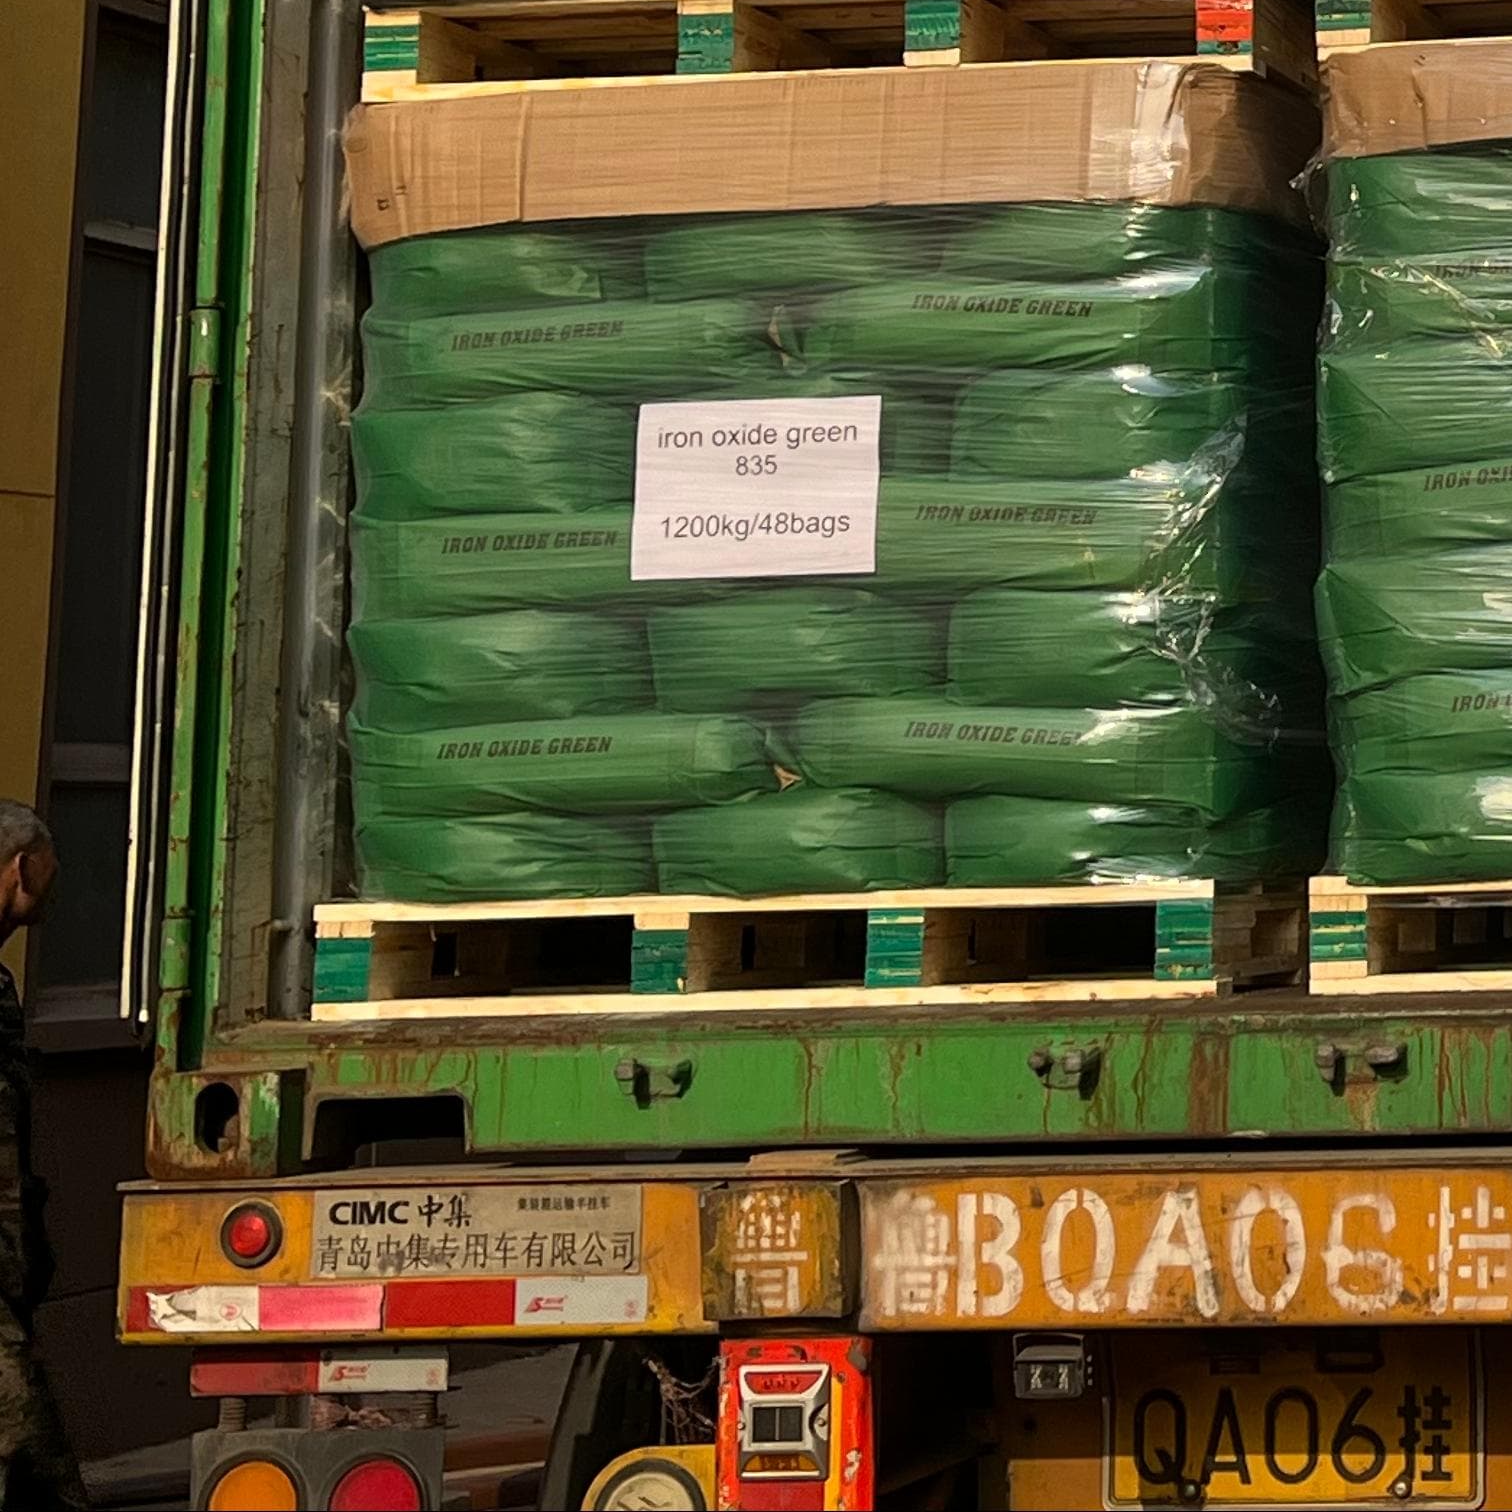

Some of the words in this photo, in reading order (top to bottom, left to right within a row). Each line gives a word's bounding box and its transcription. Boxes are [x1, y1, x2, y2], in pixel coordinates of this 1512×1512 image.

[912, 294, 961, 311] IRON
[963, 296, 1024, 314] OXIDE
[1025, 299, 1094, 318] GREEN
[451, 331, 497, 352] IRON
[500, 327, 557, 346] OXIDE
[559, 320, 625, 341] GREEN
[657, 426, 702, 449] iron
[711, 423, 778, 447] oxide
[786, 425, 858, 450] green
[735, 455, 779, 476] 835
[1423, 471, 1472, 492] IRON
[915, 504, 965, 521] IRON
[968, 505, 1028, 522] OXIDE
[660, 512, 851, 542] 1200kg/48bags
[441, 536, 487, 554] IRON
[492, 531, 551, 552] OXIDE
[553, 530, 619, 549] GREEN
[1452, 693, 1499, 713] IRON
[903, 720, 955, 739] IRON
[957, 723, 1019, 743] OXIDE
[436, 741, 484, 760] IRON
[487, 738, 544, 758] OXIDE
[546, 735, 613, 755] GREEN
[328, 1200, 410, 1225] CIMC
[417, 1194, 472, 1229] 中集
[317, 1231, 637, 1273] 青岛中集专用车有限公司
